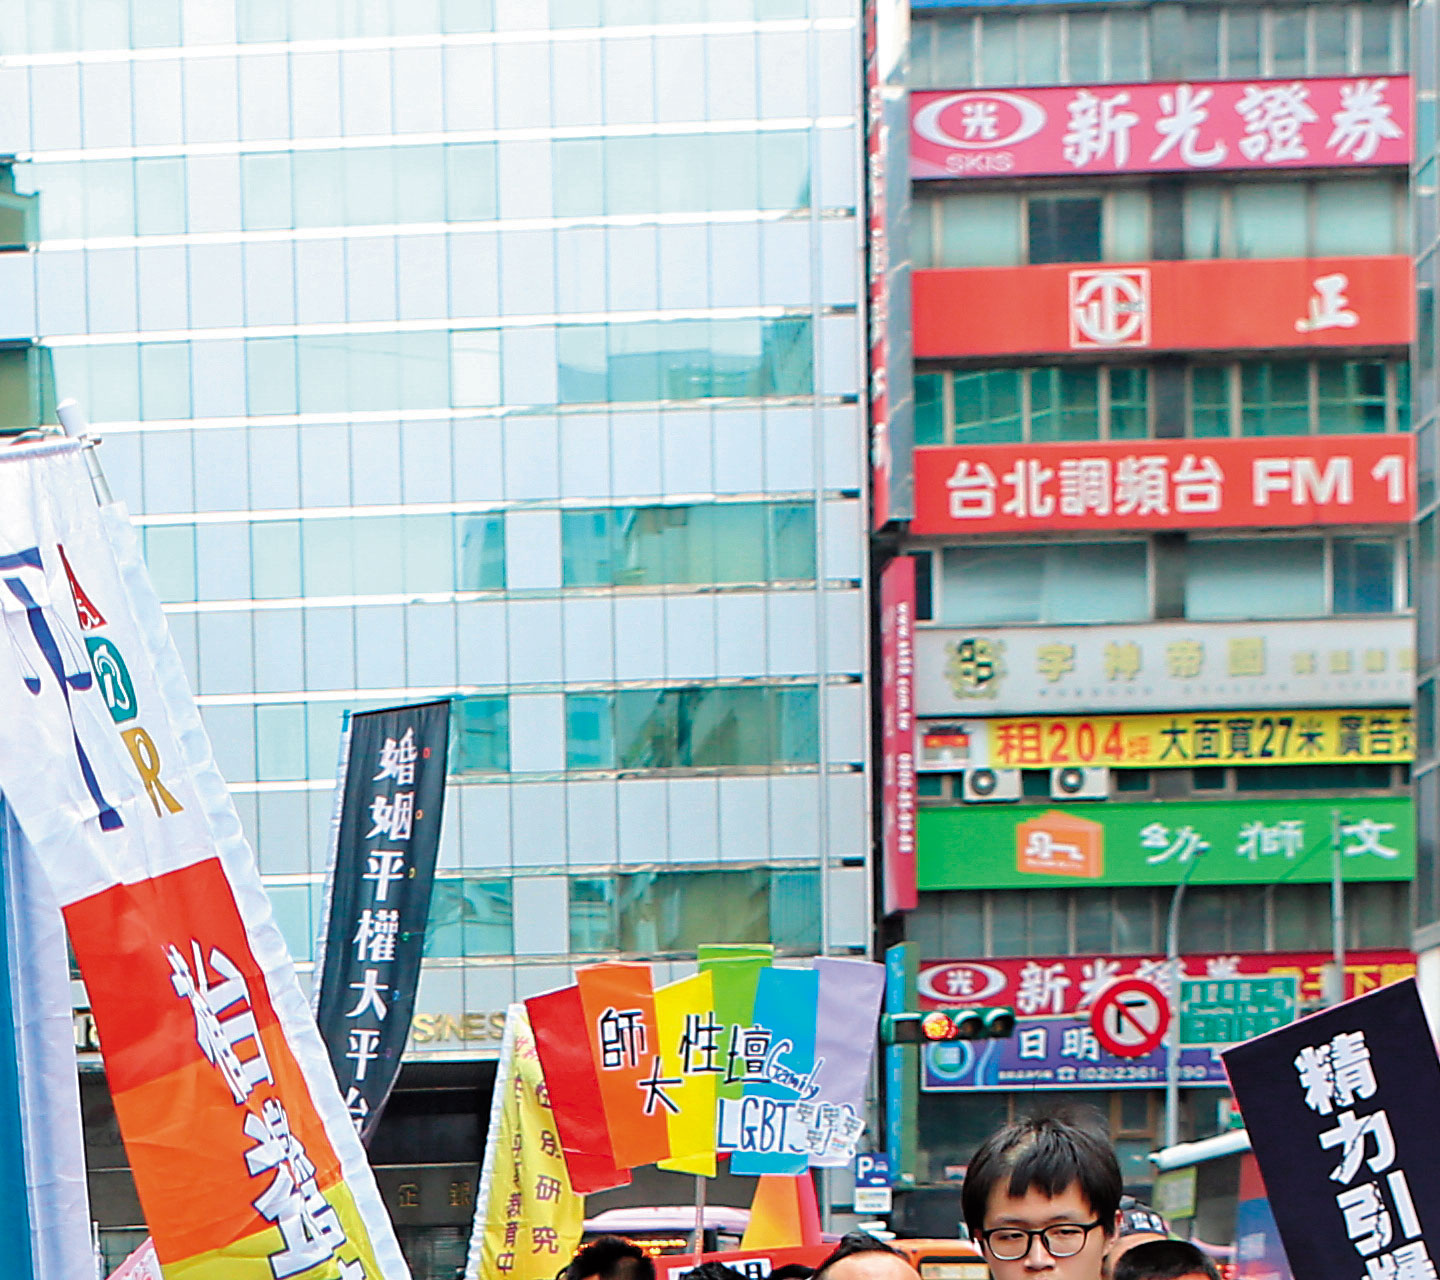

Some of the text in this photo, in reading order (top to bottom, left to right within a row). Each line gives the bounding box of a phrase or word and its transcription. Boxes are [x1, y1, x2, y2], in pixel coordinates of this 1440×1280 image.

[1060, 80, 1405, 171] 新光證券
[946, 455, 1225, 520] 台北調頻台
[1252, 455, 1414, 506] FM 1
